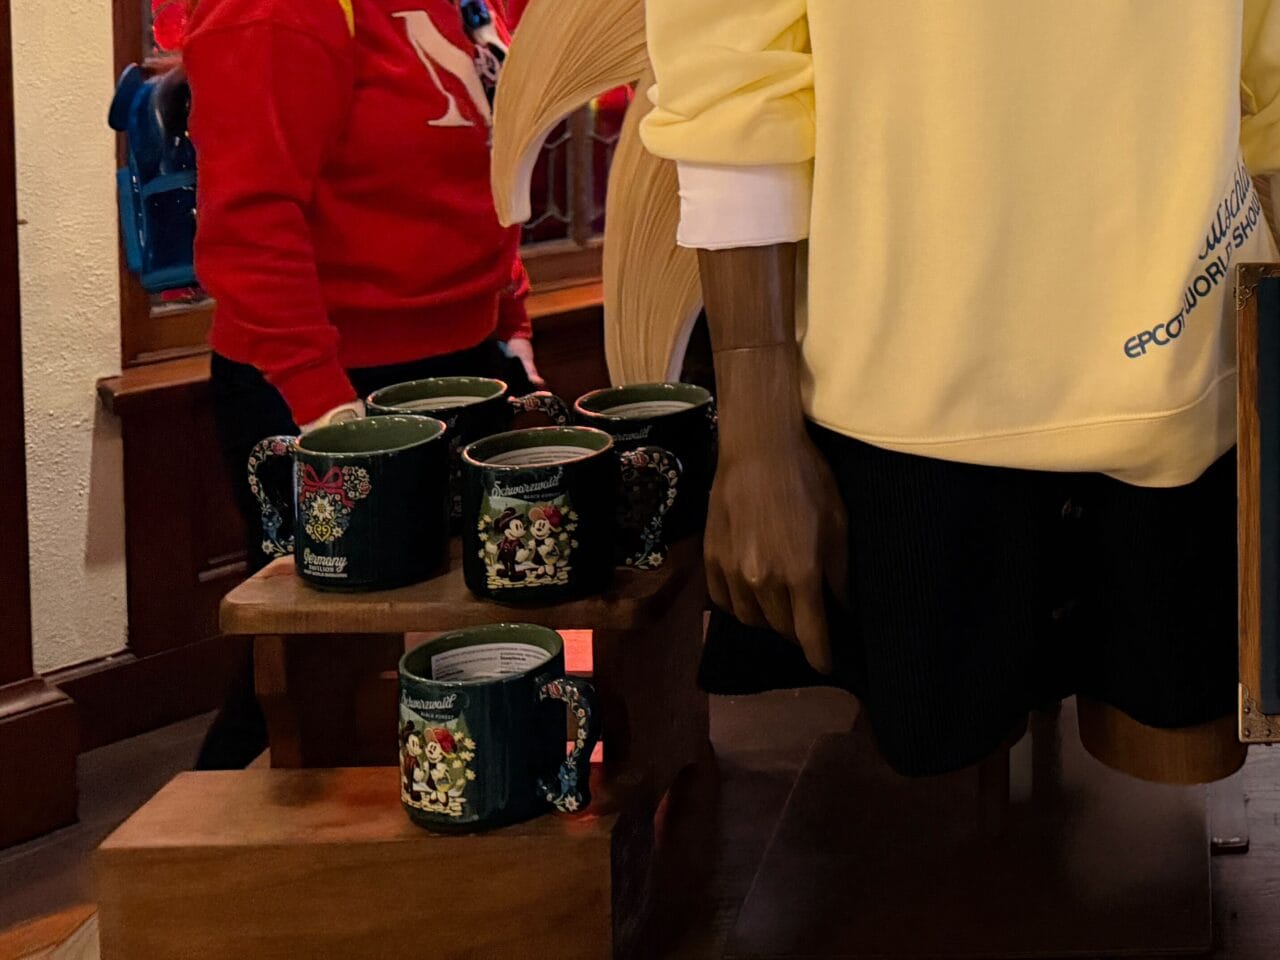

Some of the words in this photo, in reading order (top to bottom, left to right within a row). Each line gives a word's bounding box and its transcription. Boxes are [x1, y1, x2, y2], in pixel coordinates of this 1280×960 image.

[1123, 307, 1185, 359] EPCOT
[491, 466, 563, 498] Schwarzwald
[303, 547, 348, 573] Germany
